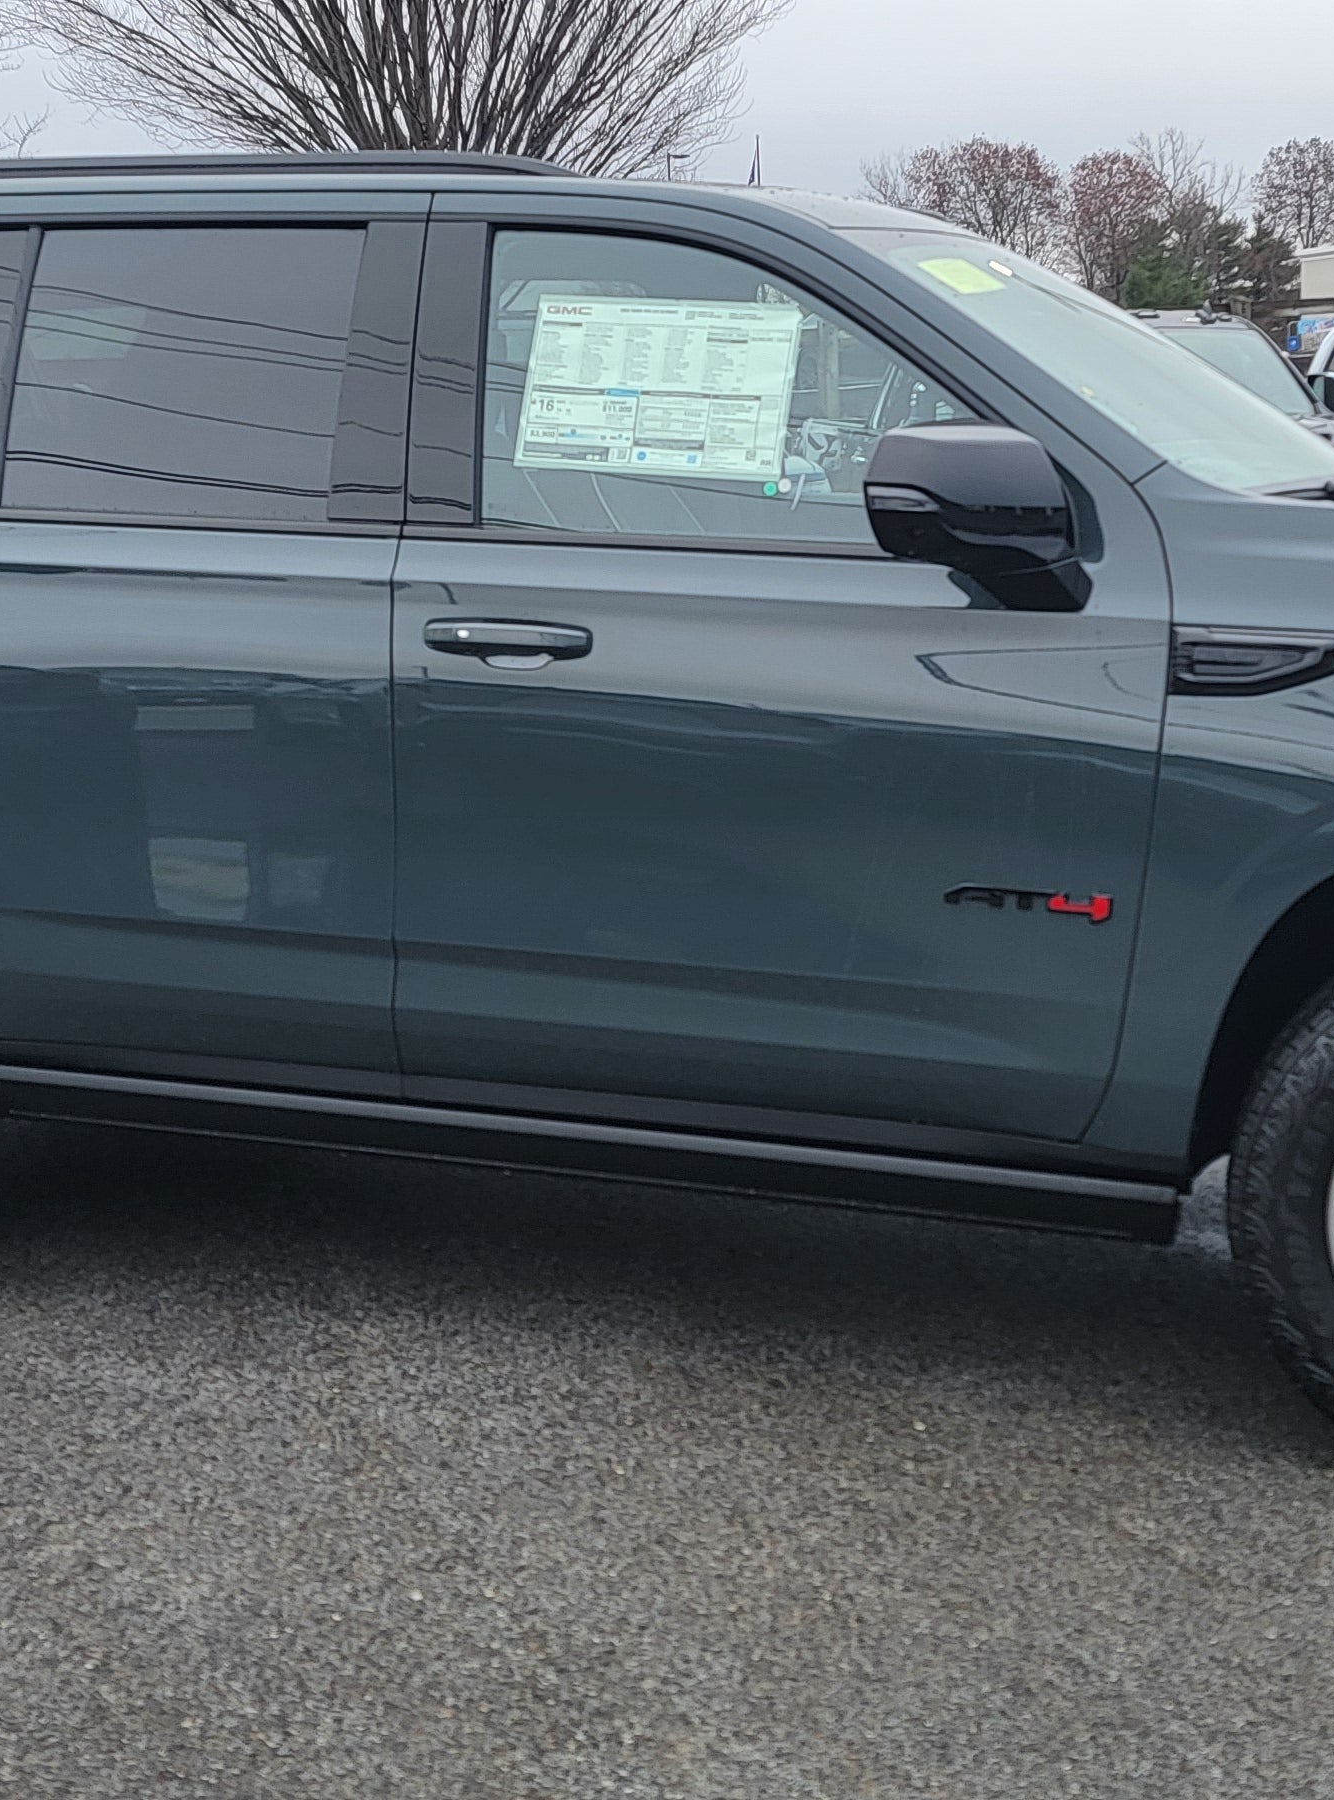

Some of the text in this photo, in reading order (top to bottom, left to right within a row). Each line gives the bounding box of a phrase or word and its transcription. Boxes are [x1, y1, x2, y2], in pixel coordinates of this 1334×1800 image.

[546, 305, 593, 316] GMC
[538, 399, 555, 412] 16
[943, 883, 1114, 925] AT4
